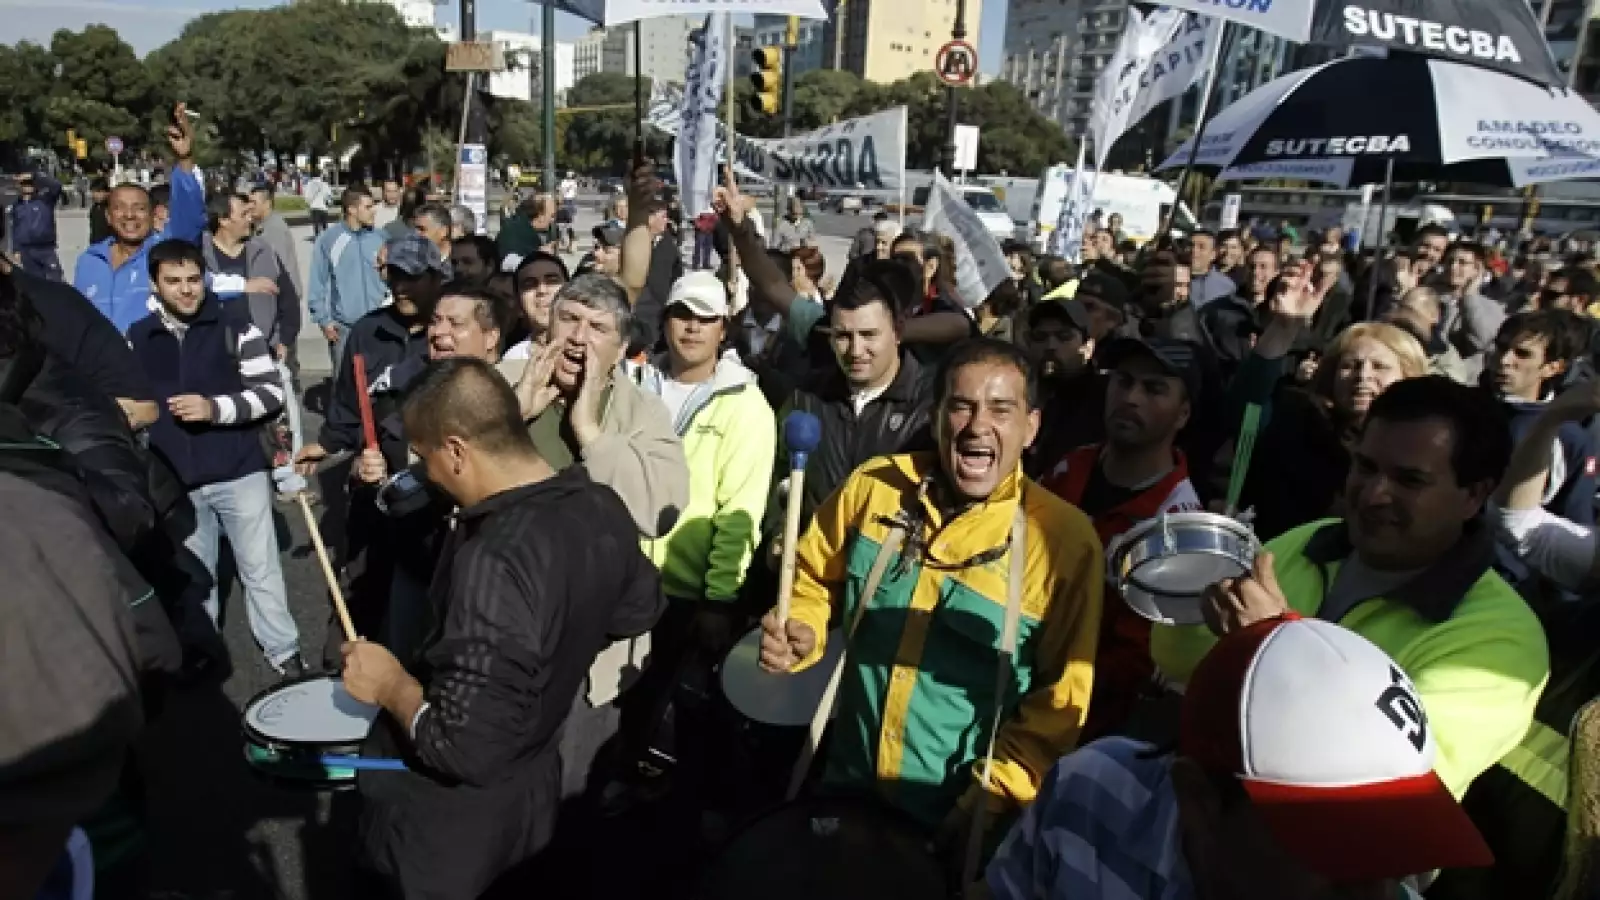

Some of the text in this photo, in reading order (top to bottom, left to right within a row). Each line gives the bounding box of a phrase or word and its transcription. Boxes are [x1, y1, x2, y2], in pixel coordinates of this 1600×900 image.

[1343, 4, 1522, 63] SUTECBA
[1476, 119, 1583, 134] AMADEO
[1265, 132, 1411, 156] SUTECBA
